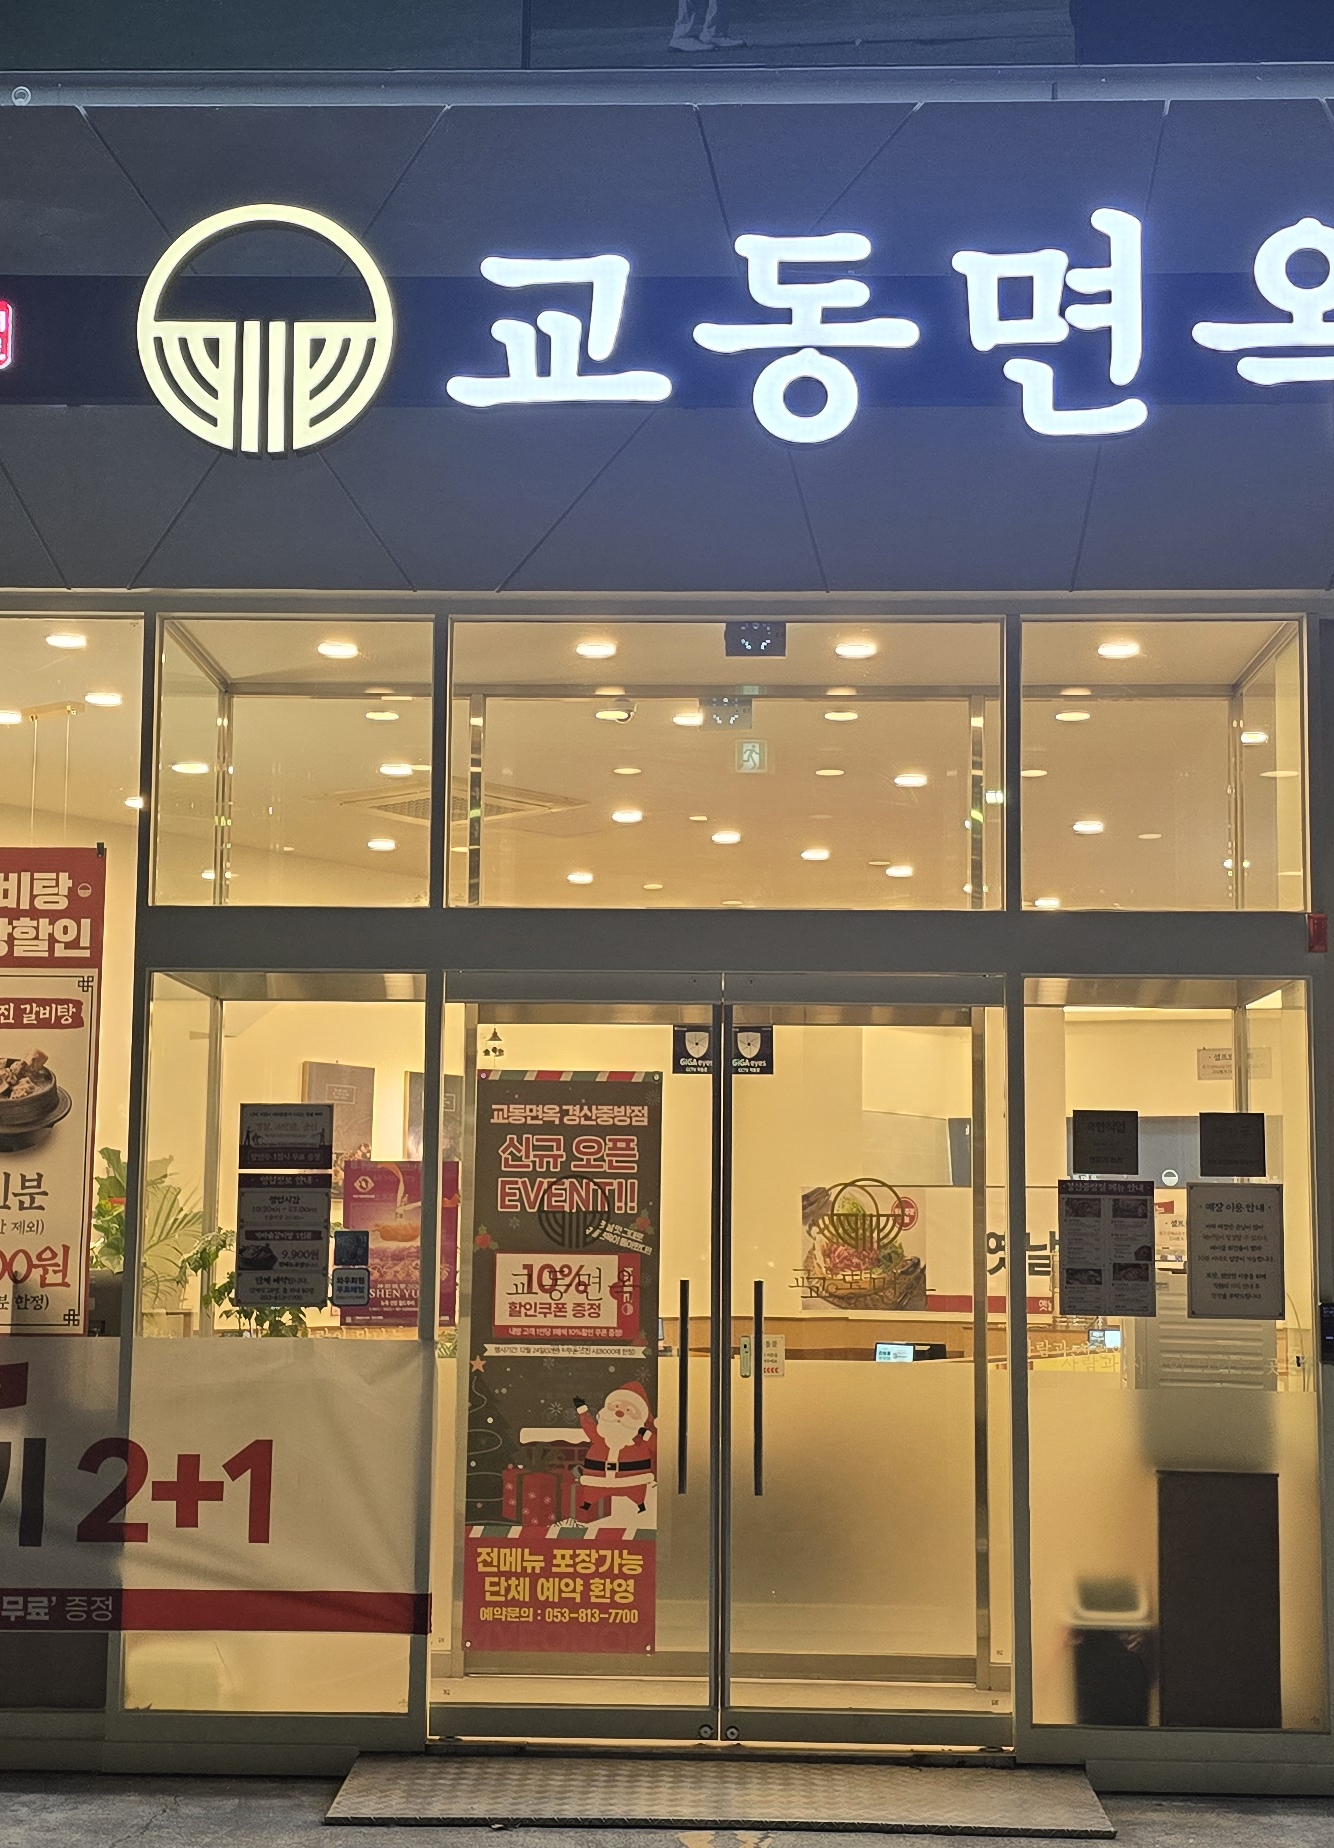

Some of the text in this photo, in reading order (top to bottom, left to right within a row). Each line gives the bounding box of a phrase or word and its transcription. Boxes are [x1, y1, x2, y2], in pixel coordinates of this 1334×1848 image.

[20, 1002, 76, 1025] 갈비탕
[731, 1057, 767, 1068] GIGA eyes
[490, 1104, 649, 1126] 교동면옥 경산중방점
[498, 1134, 639, 1173] 신규 오픈
[497, 1177, 638, 1214] EVENT!!
[1127, 1183, 1145, 1193] 안내
[1205, 1202, 1265, 1213] 매장 이용 안내
[11, 1218, 45, 1236] 제외)
[522, 1263, 589, 1295] 10%
[14, 1293, 49, 1312] 한정)
[369, 1288, 420, 1299] SHEN YU
[508, 1301, 601, 1319] 할인쿠폰 증정
[76, 1437, 274, 1545] 2+1
[476, 1548, 644, 1575] 전메뉴 포장가능
[484, 1576, 635, 1604] 단체 예약 환영
[65, 1597, 114, 1621] 증정
[479, 1607, 639, 1624] 예약문의 053-813-7700
